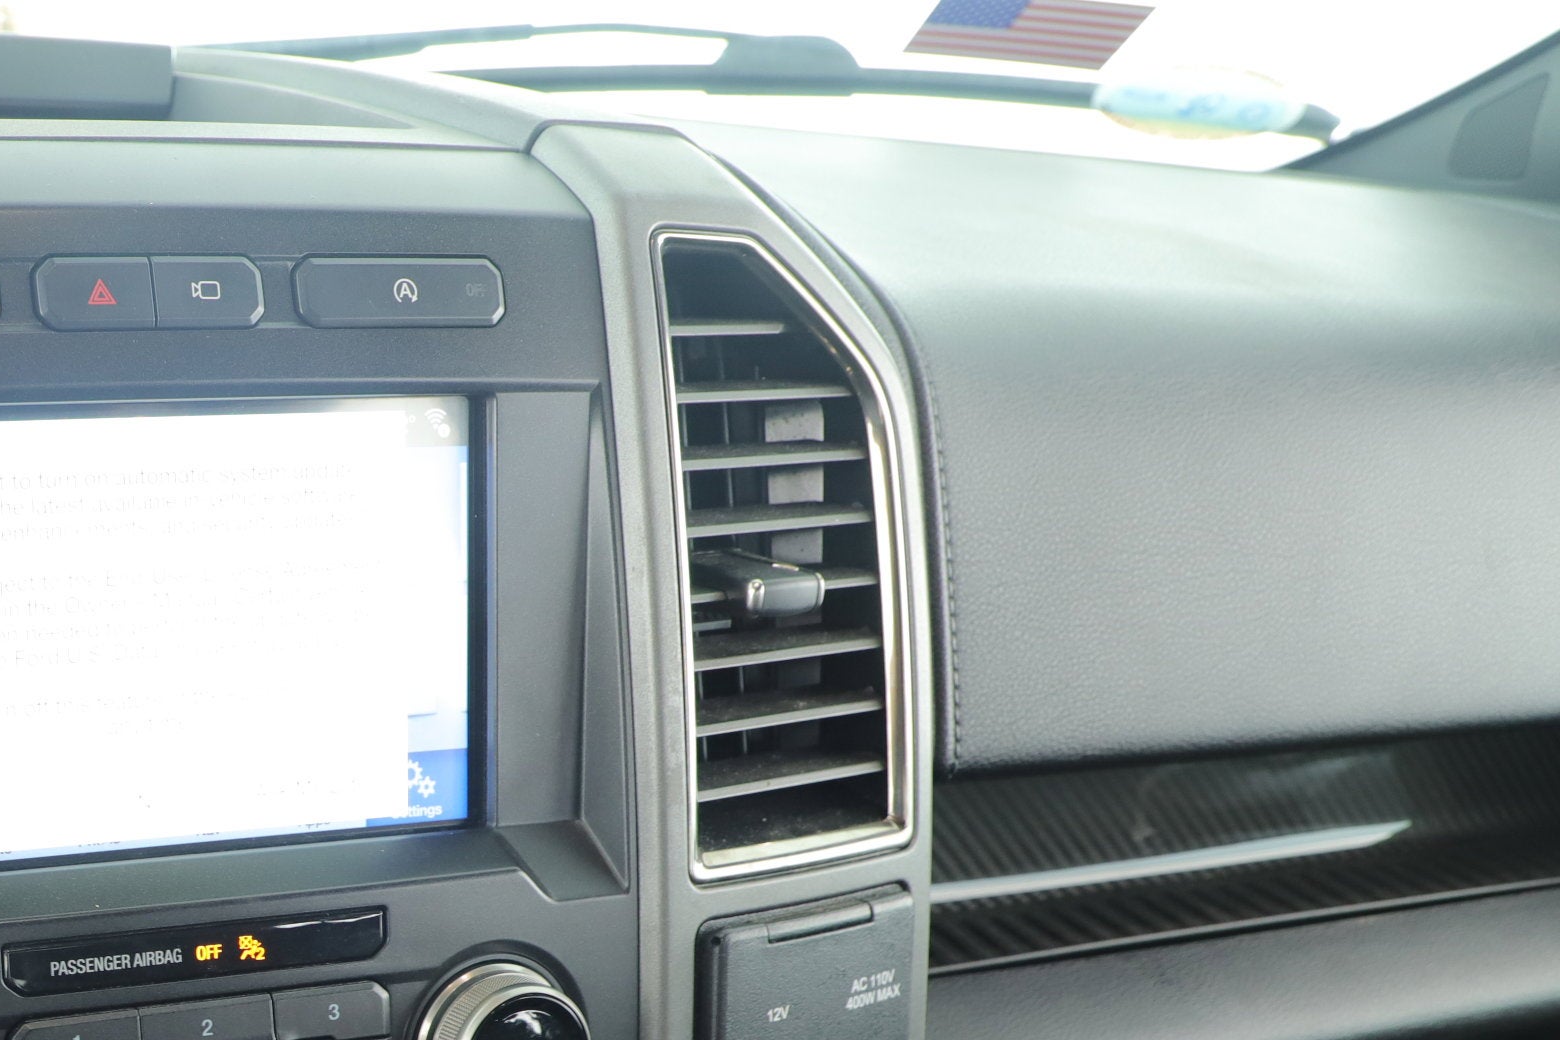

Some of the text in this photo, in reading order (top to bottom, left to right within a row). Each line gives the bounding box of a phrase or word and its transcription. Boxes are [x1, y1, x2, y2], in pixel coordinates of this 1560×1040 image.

[12, 475, 31, 490] to
[50, 944, 223, 977] PASSENGER AIRBAG OFF
[851, 968, 896, 993] AC 110V
[845, 983, 901, 1011] 400W MAX
[328, 1004, 340, 1020] 3
[766, 1004, 790, 1022] 12V
[201, 1019, 214, 1036] 2
